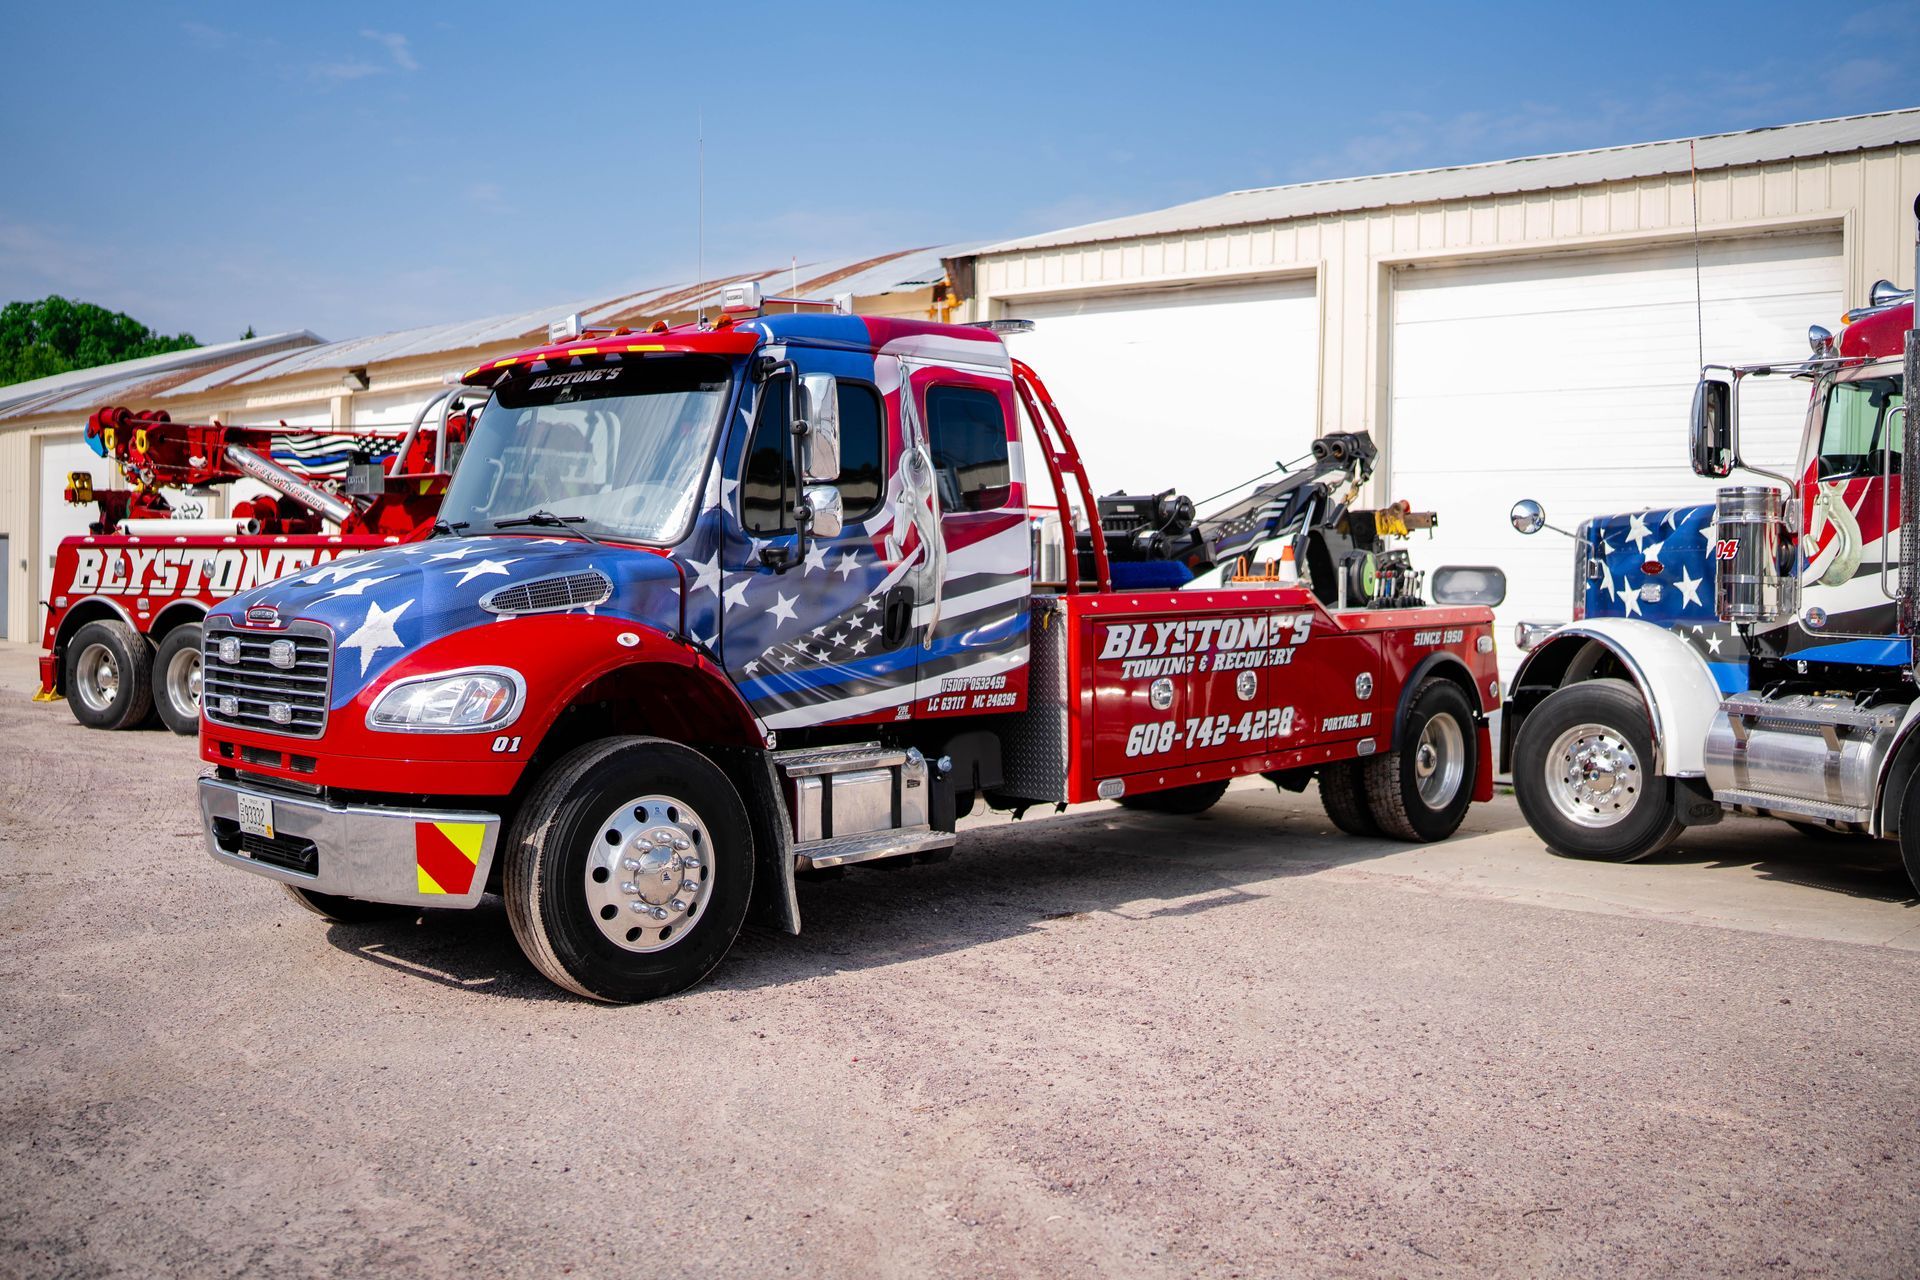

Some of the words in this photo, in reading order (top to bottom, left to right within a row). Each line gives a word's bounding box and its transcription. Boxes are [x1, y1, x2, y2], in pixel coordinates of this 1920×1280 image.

[529, 366, 624, 390] BLYSTONE'S
[1716, 539, 1740, 560] 04
[1098, 613, 1314, 660] BLYSTONE'S
[1413, 631, 1441, 646] SINCE
[1442, 629, 1464, 644] 1950
[1120, 656, 1195, 680] TOWING
[1198, 655, 1209, 673] &
[1211, 647, 1296, 672] RECOVERY
[927, 698, 940, 712] LC
[940, 696, 967, 711] 63717
[971, 694, 986, 709] MC
[986, 692, 1018, 708] 248396
[1125, 706, 1295, 758] 608-742-4228
[1321, 714, 1360, 733] PORTAGE,
[1360, 712, 1373, 727] WI
[491, 735, 523, 753] 01
